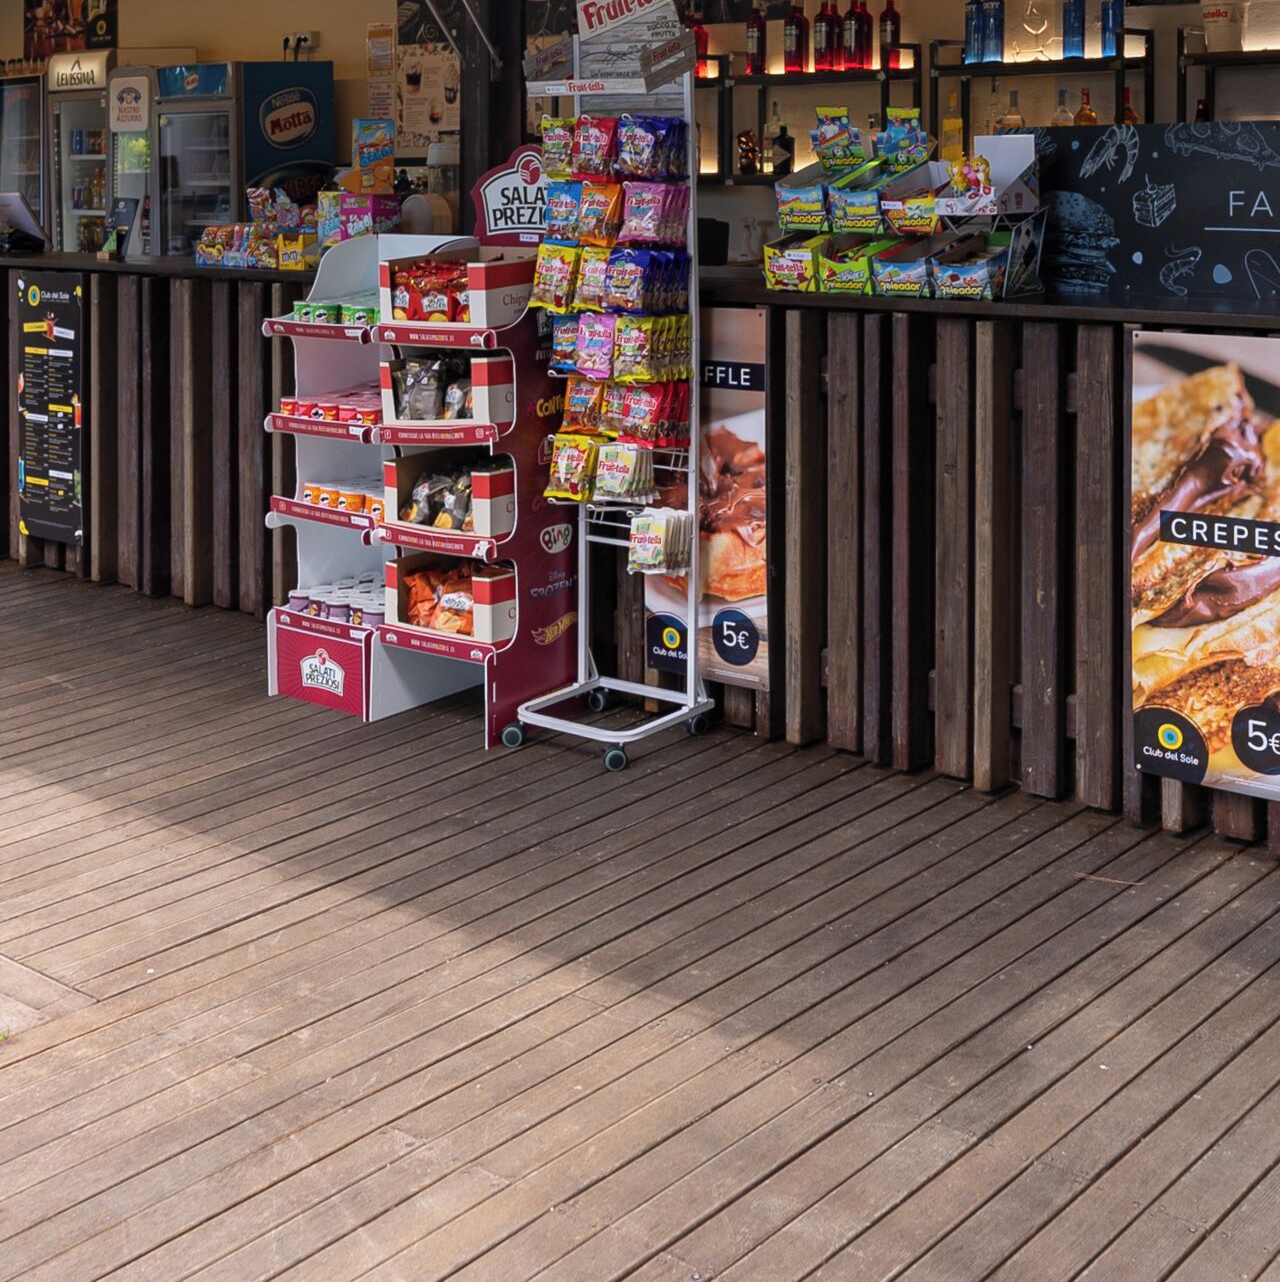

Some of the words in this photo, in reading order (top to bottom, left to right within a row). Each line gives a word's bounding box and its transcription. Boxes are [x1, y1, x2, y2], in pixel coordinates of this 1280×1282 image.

[1203, 9, 1228, 19] utella
[57, 69, 96, 86] LEVISSIMA
[568, 81, 606, 92] Fruit-tella
[270, 110, 312, 135] Motta
[500, 186, 547, 206] SALA
[492, 206, 547, 227] PREZI
[705, 366, 750, 385] FFLE
[723, 621, 749, 649] 5€
[653, 646, 667, 656] Club
[668, 650, 677, 658] del
[678, 651, 688, 660] Sol
[305, 672, 340, 689] PREZIOSI
[309, 664, 335, 679] SALATI
[1143, 746, 1163, 758] Club
[1165, 750, 1178, 761] del
[1180, 753, 1199, 765] Sole
